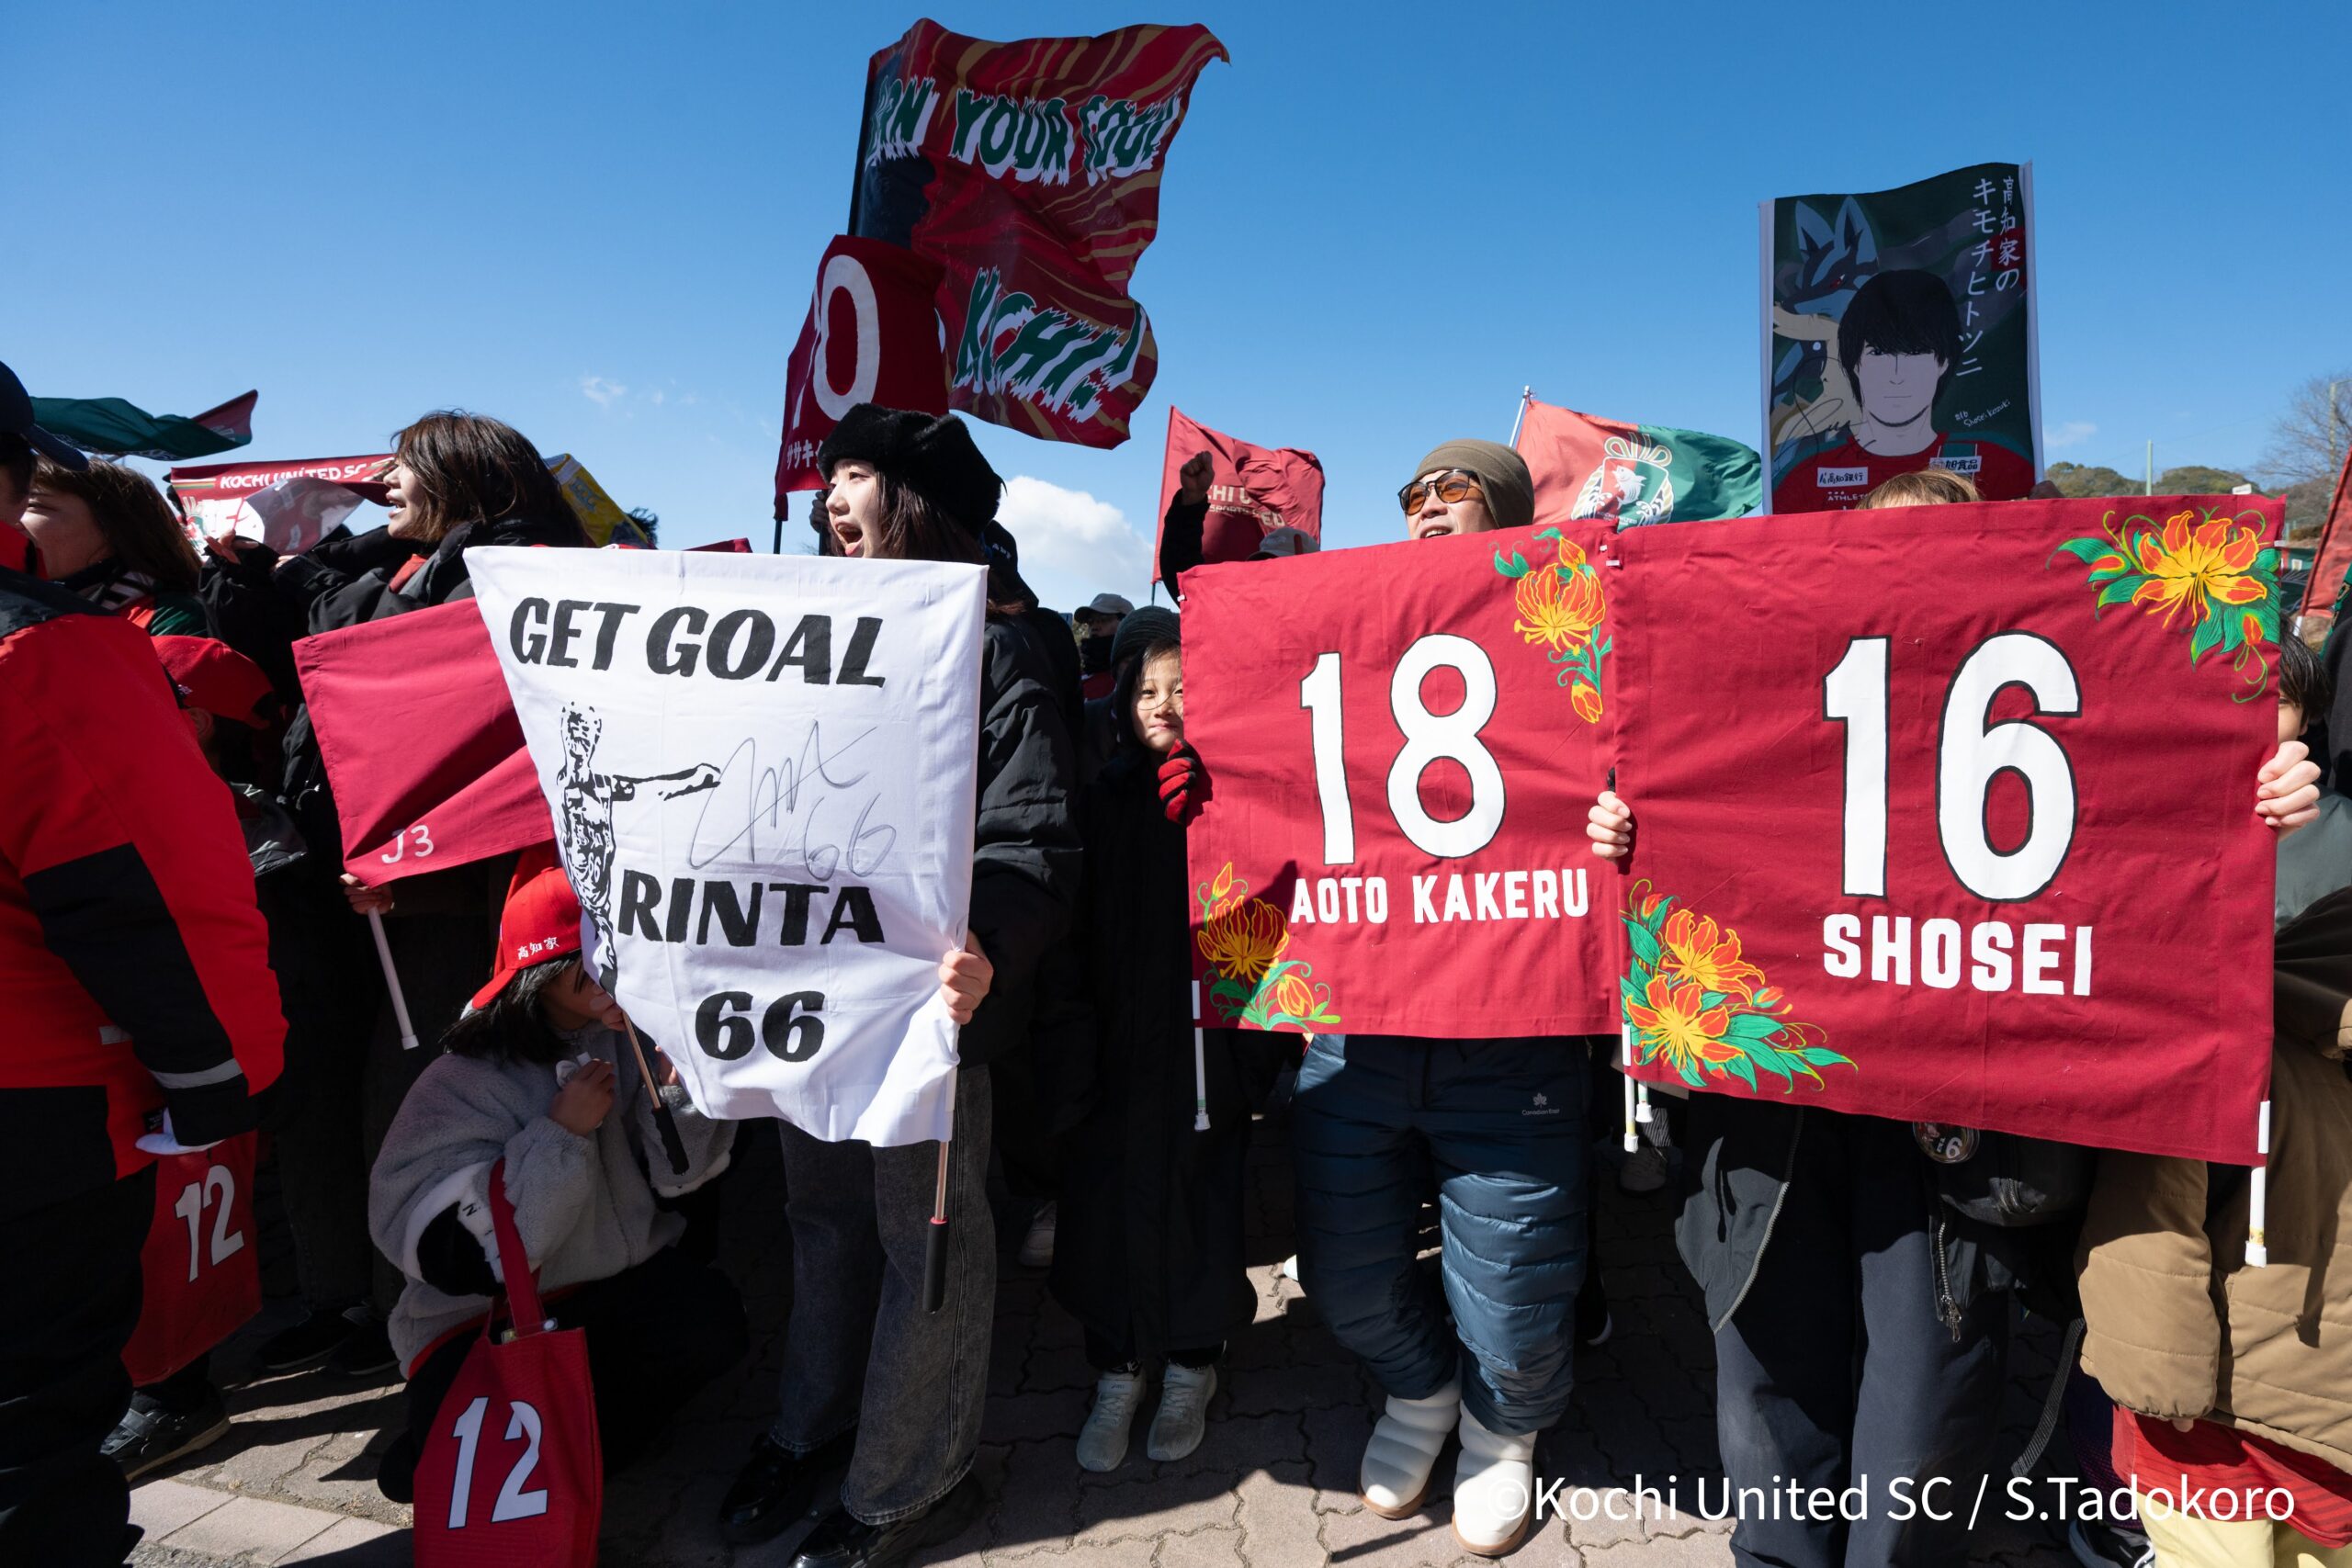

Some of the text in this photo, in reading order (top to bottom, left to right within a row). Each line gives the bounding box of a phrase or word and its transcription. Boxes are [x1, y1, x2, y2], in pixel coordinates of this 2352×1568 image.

[948, 88, 1074, 187] YOUR
[1995, 175, 2020, 292] 高知家の
[1956, 178, 1996, 377] キモチヒトツニ
[220, 475, 270, 489] KOCHI
[1826, 472, 1863, 485] 高知銀行
[1827, 492, 1869, 502] ATHLET
[1945, 459, 1978, 470] 旭食品
[510, 596, 886, 688] GET GOAL
[1299, 632, 1507, 866] 18
[1822, 628, 2083, 903] 16
[380, 824, 434, 864] J3
[617, 868, 885, 947] RINTA
[1291, 868, 1589, 925] AOTO KAKERU
[517, 936, 560, 961] 高知家
[1823, 913, 2094, 997] SHOSEI
[695, 990, 826, 1063] 66
[174, 1164, 246, 1283] 12
[447, 1395, 549, 1530] 12
